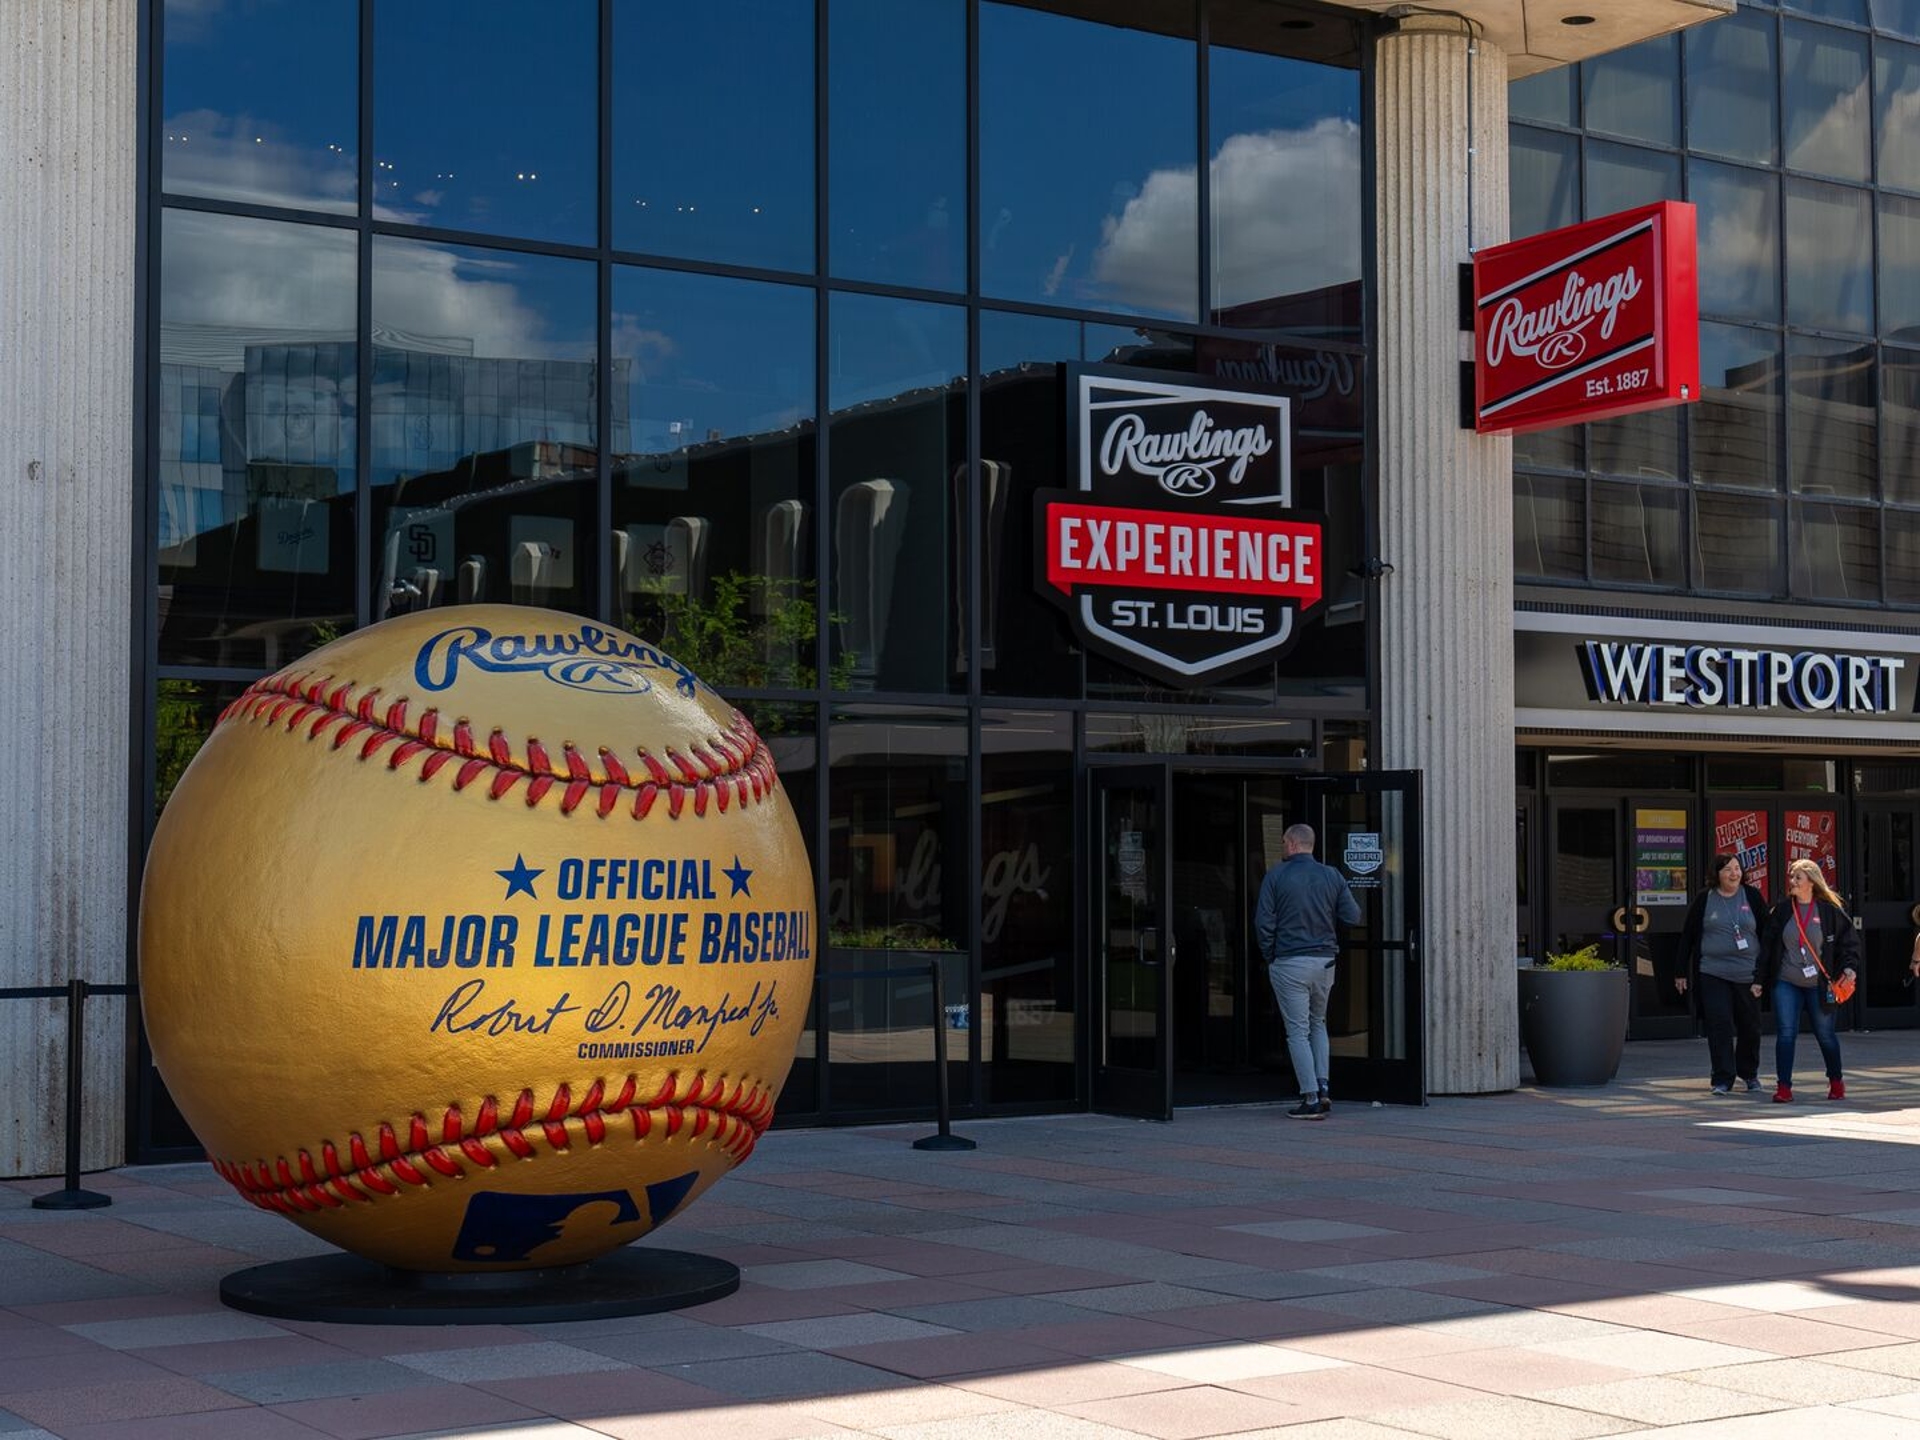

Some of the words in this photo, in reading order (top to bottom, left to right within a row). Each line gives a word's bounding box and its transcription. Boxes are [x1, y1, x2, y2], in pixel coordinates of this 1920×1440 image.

[1487, 265, 1642, 367] Rawlings
[1585, 376, 1615, 398] Est.
[1616, 368, 1650, 392] 1887
[1100, 410, 1273, 485] Rawlings
[1060, 516, 1315, 585] EXPERIENCE
[1111, 599, 1160, 629] ST.
[1166, 602, 1265, 634] LOUIS
[414, 625, 718, 699] Rawling
[1598, 642, 1905, 711] WESTPORT
[1715, 812, 1759, 849] HATS
[1785, 828, 1819, 848] EVERYONE
[1796, 814, 1811, 830] FOR
[557, 857, 716, 901] OFFICIAL
[352, 915, 519, 969] MAJOR
[533, 912, 687, 968] LEAGUE
[699, 909, 811, 965] BASEBALL
[577, 1039, 696, 1060] COMMISSIONER
